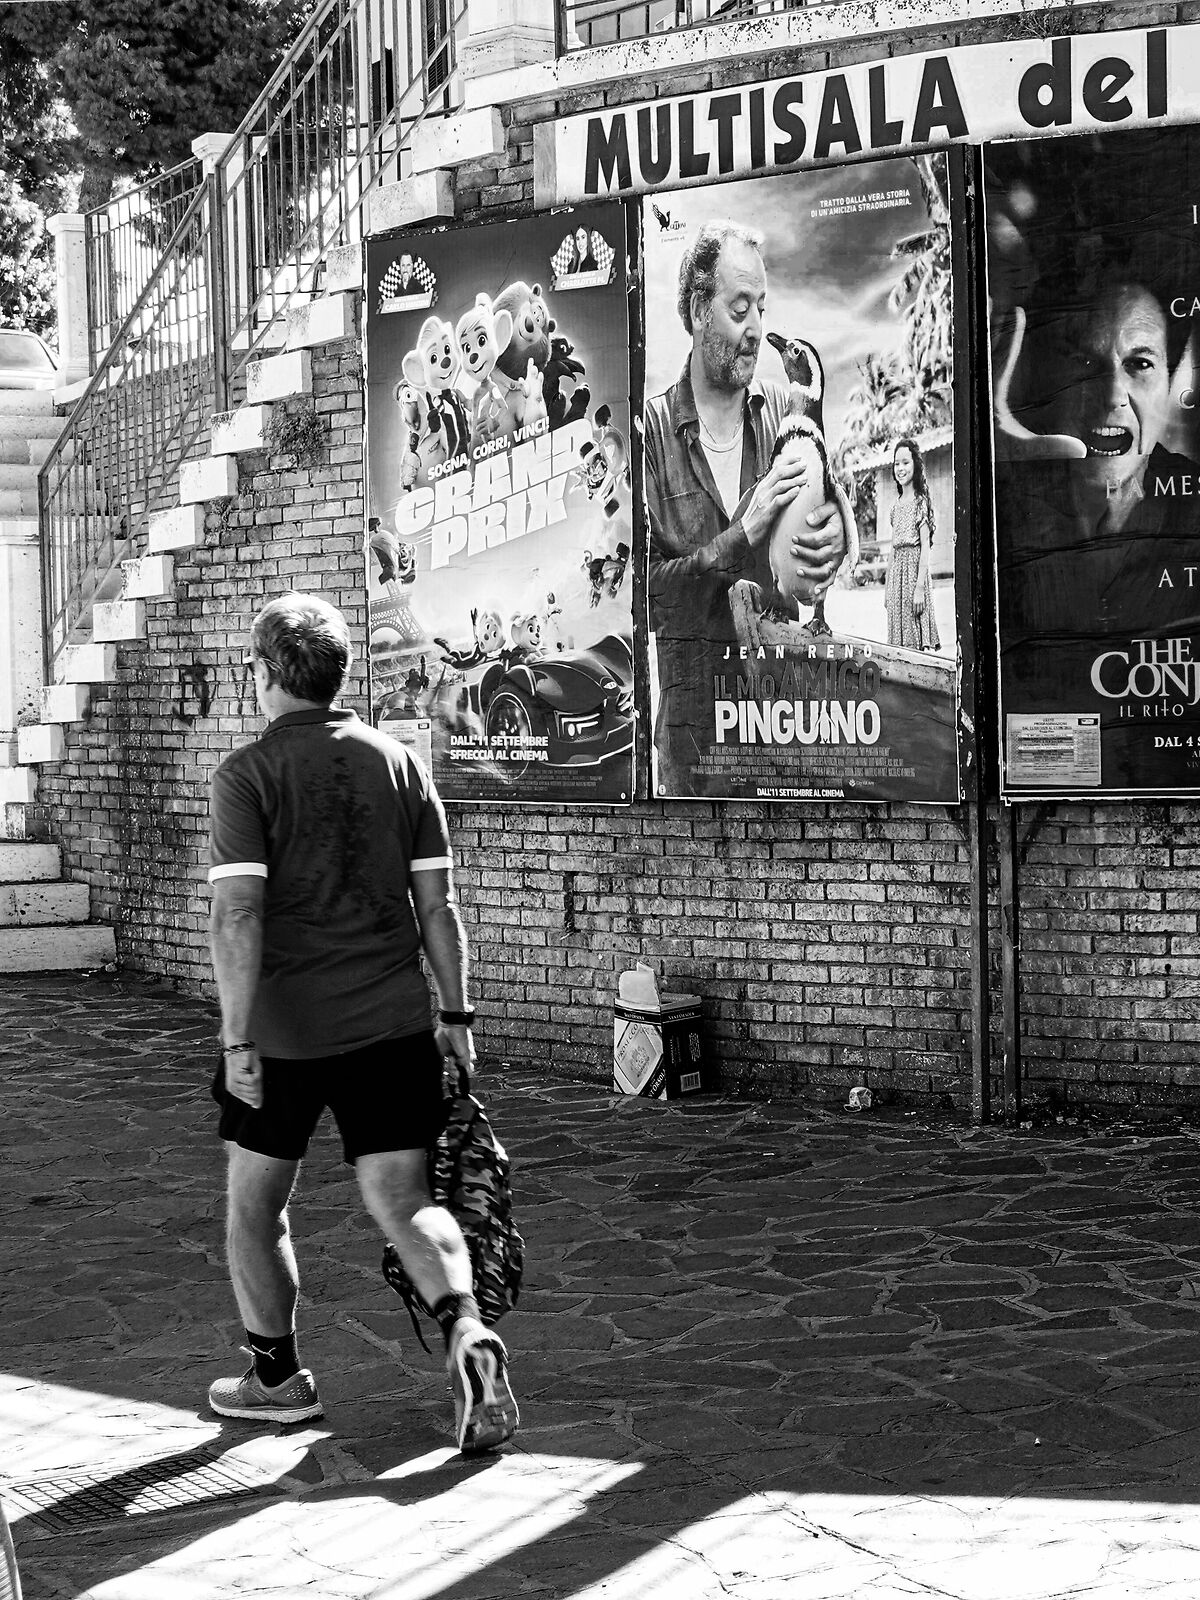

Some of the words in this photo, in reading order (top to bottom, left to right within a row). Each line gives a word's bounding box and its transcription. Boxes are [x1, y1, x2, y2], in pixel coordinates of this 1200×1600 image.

[584, 55, 970, 195] MULTISALA
[1017, 28, 1167, 128] del
[810, 209, 818, 218] DI
[818, 205, 857, 217] UN'AMICIZIA
[858, 198, 912, 212] STRAORDINARIA.
[820, 198, 845, 208] TRATTO
[845, 194, 867, 205] DALLA
[867, 192, 886, 202] VERA
[886, 189, 911, 199] STORIA
[427, 453, 472, 481] SOGNA,
[472, 434, 511, 460] CORRI,
[513, 416, 550, 443] VINCI!
[395, 418, 593, 535] GRAND
[1105, 478, 1145, 500] HA
[431, 473, 568, 571] PRIX
[1157, 566, 1177, 589] A
[723, 645, 785, 660] JEAN
[807, 644, 873, 659] RENO
[1131, 637, 1194, 665] THE
[714, 675, 731, 699] IL
[737, 675, 776, 699] MIO
[778, 660, 882, 700] AMICO
[1120, 705, 1134, 718] IL
[1143, 699, 1185, 717] RITO
[714, 700, 881, 745] PINGUINO
[450, 735, 488, 746] DALL'11
[490, 735, 549, 747] SETTEMBRE
[1154, 736, 1183, 748] DAL
[1186, 735, 1194, 747] 4
[450, 749, 494, 761] SFRECCIA
[495, 749, 509, 761] AL
[510, 750, 549, 761] CINEMA
[757, 788, 779, 797] DALL'11
[779, 788, 814, 798] SETTEMBRE
[814, 789, 821, 798] AL
[821, 789, 845, 799] CINEMA
